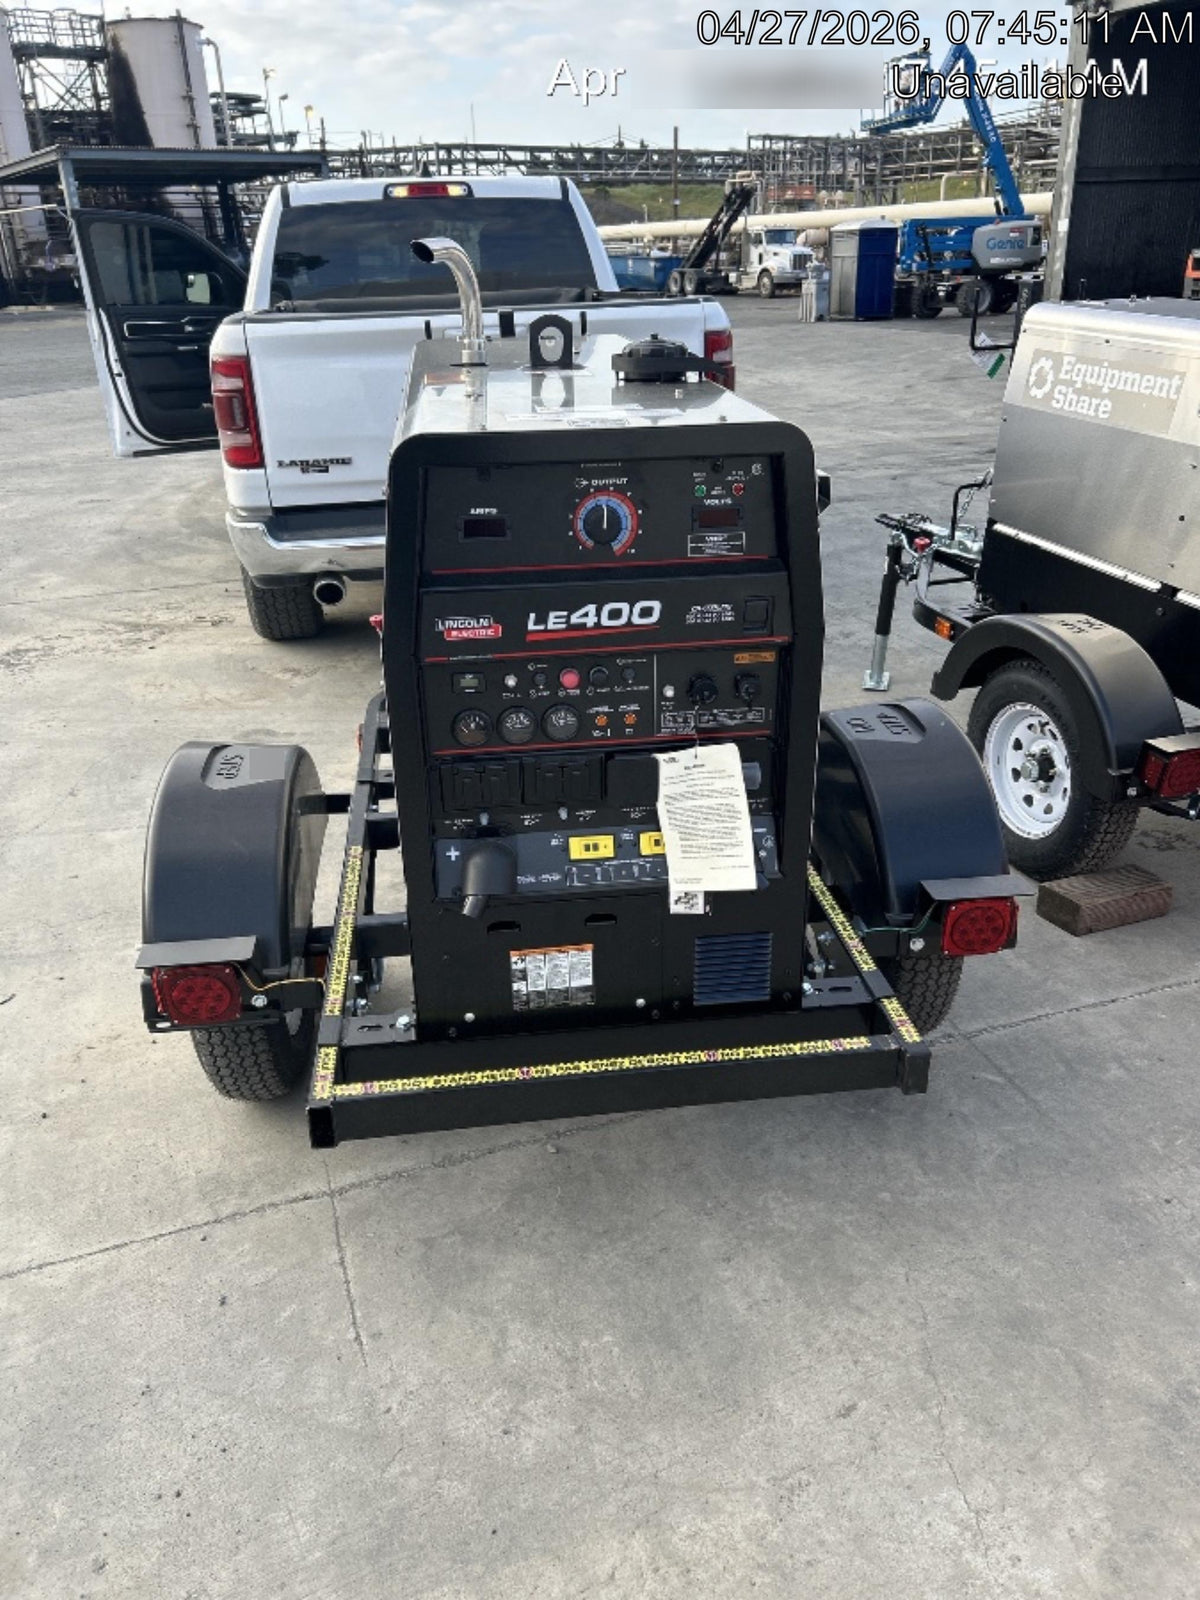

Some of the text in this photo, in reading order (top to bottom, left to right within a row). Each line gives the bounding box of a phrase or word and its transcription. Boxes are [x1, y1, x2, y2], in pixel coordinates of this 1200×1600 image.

[1059, 355, 1181, 399] Equipment
[1052, 384, 1113, 418] Share
[591, 477, 628, 486] OUTPUT
[438, 618, 490, 632] LINCOLN
[527, 600, 662, 631] LE400
[451, 628, 495, 638] ELECTRIC
